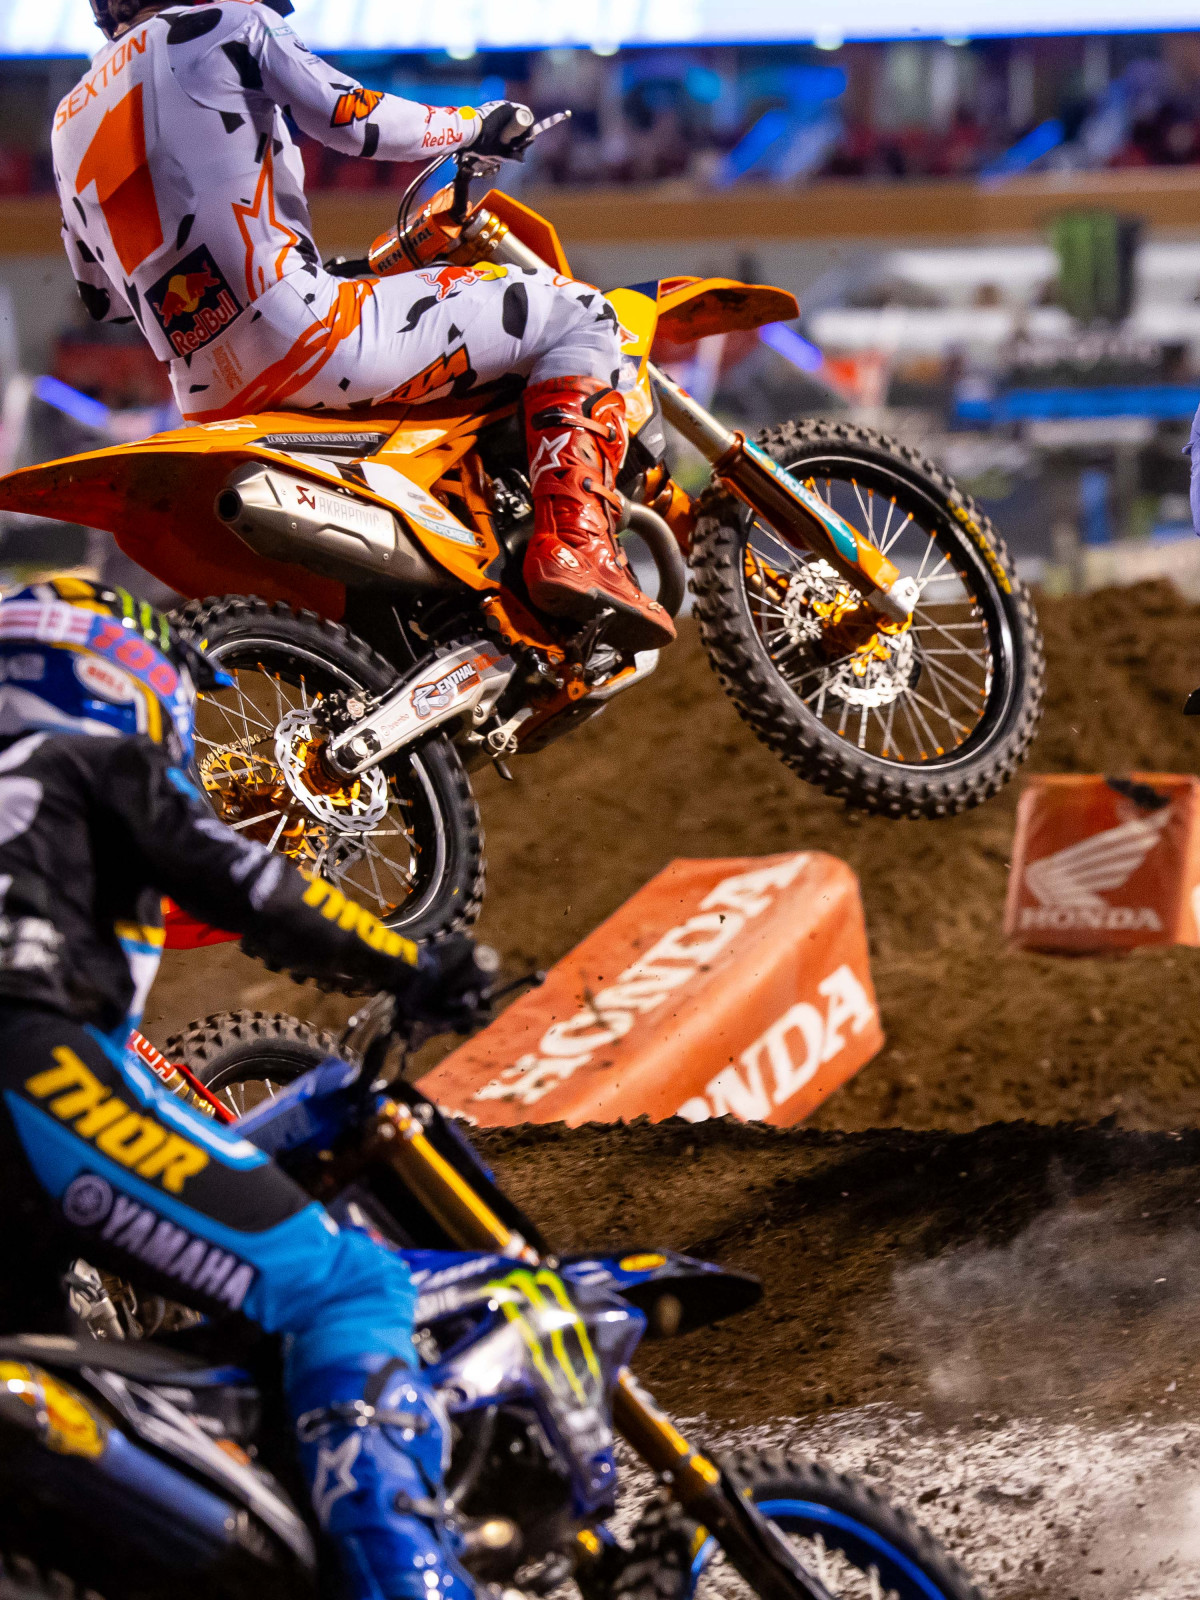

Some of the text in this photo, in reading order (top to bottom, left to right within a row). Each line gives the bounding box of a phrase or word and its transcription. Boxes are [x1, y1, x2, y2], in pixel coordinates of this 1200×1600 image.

[56, 29, 147, 131] SEXTON
[75, 82, 165, 276] 1
[421, 128, 446, 148] Red
[377, 227, 434, 273] RENHAL
[170, 289, 239, 356] Red Bull
[412, 663, 476, 718] RENTHAL
[1018, 906, 1163, 933] HONDA
[473, 853, 810, 1105] HONDA
[673, 963, 876, 1121] NDA
[24, 1045, 210, 1194] THOR
[101, 1194, 254, 1311] YAMAHA
